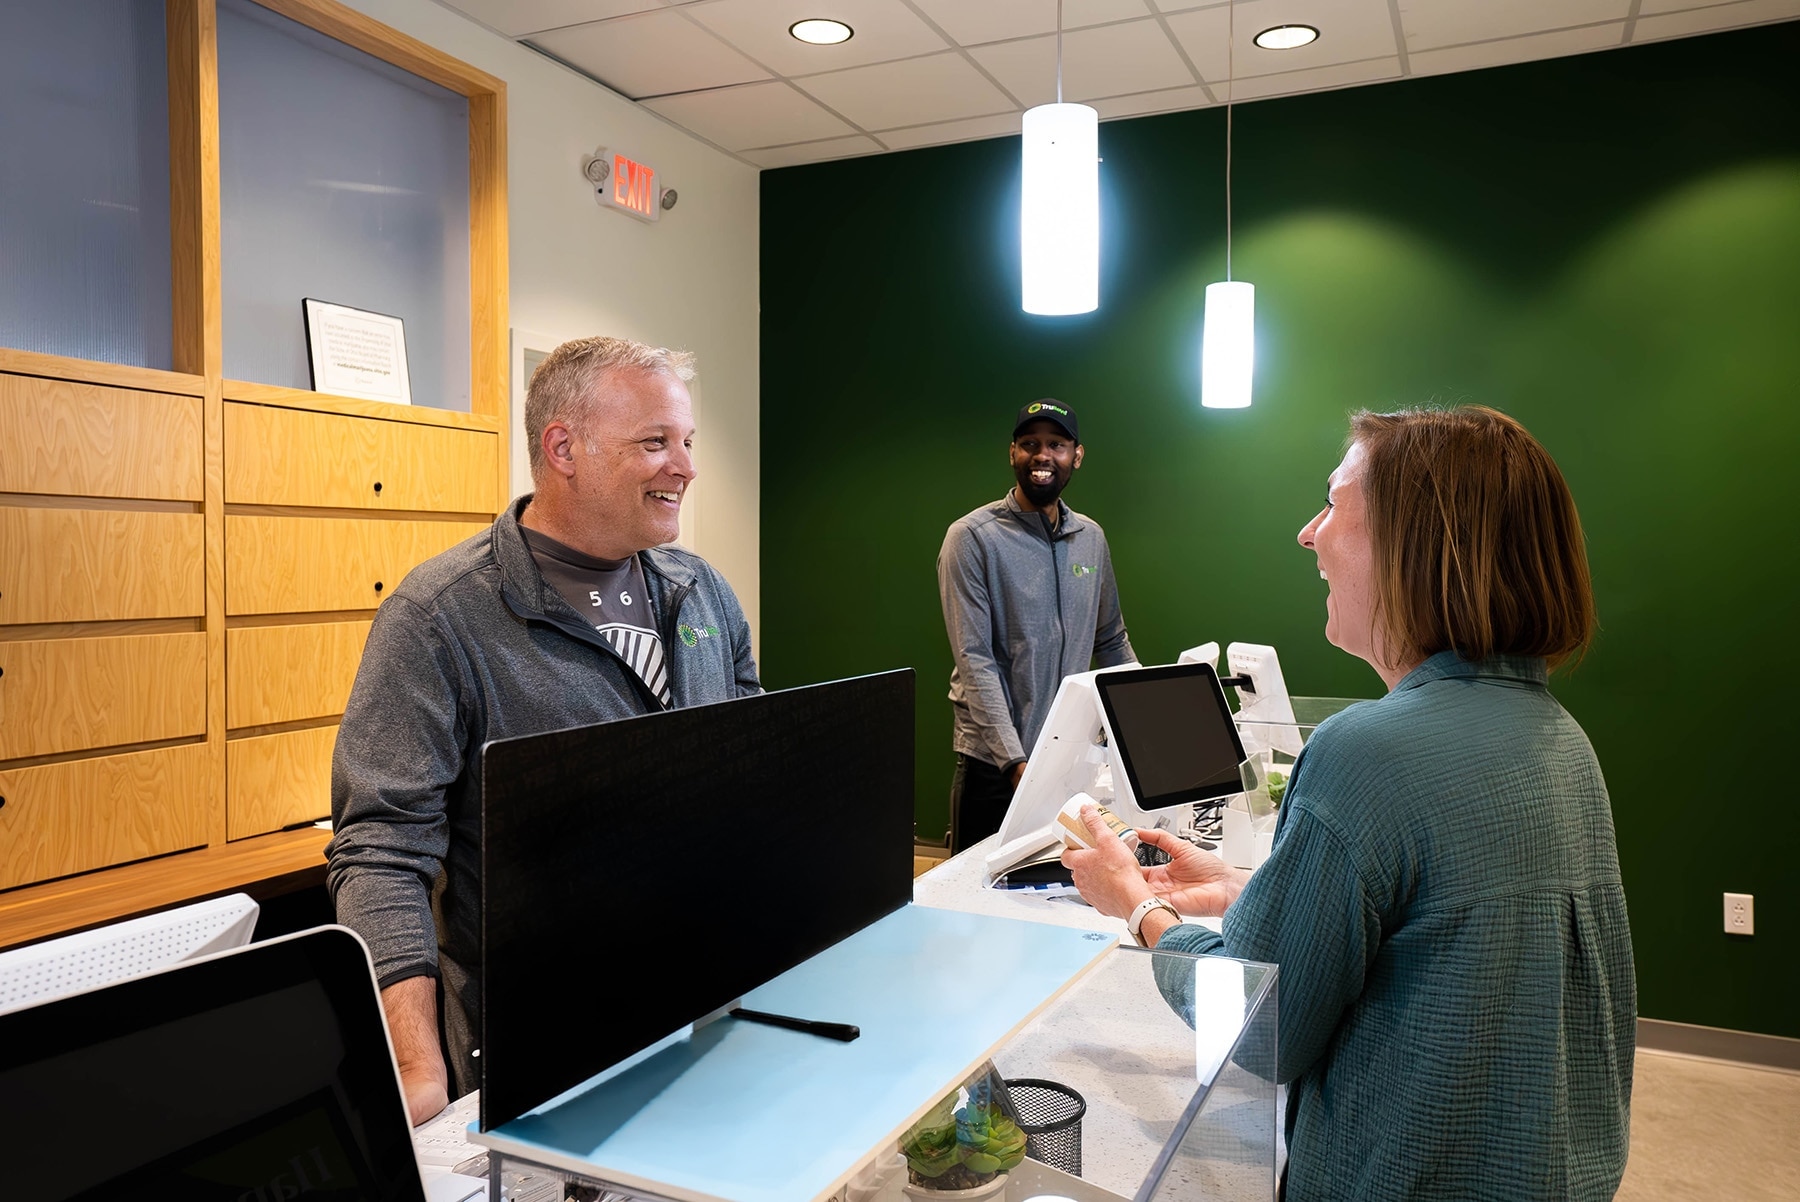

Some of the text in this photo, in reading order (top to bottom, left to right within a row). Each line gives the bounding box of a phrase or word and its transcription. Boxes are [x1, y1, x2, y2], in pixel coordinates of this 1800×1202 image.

[614, 154, 654, 216] EXIT
[589, 591, 632, 607] 5 6
